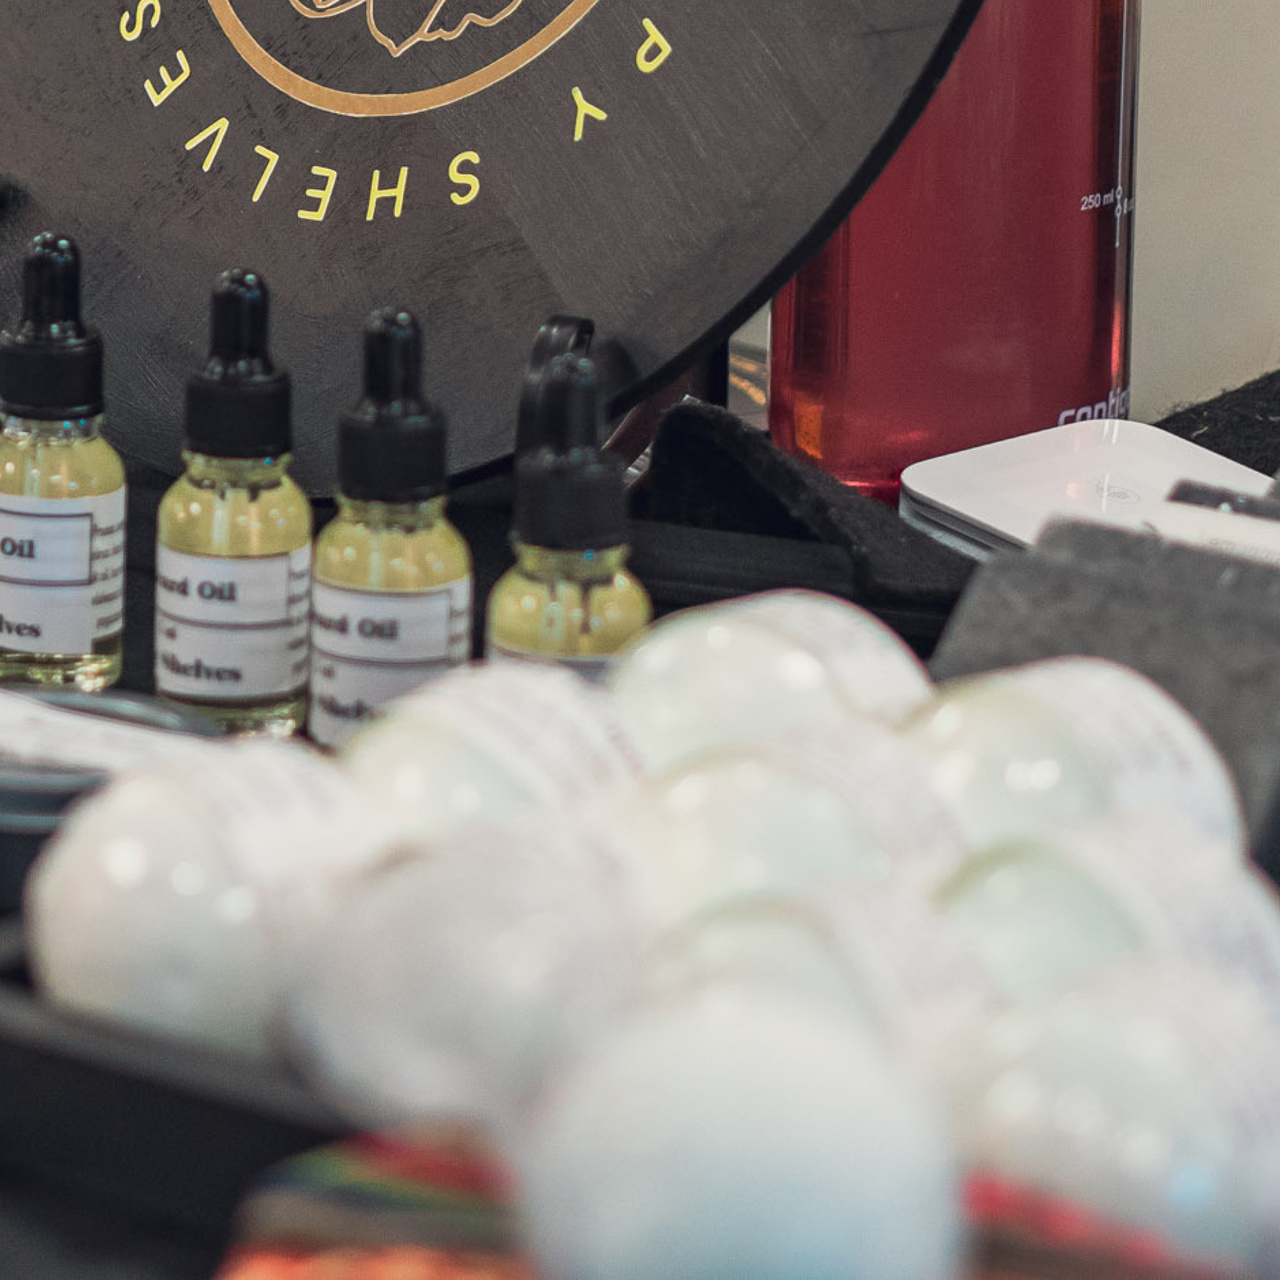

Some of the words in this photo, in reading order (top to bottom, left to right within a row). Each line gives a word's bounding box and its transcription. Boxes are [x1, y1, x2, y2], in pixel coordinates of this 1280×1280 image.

[1080, 193, 1101, 211] 250
[1102, 188, 1114, 206] ml
[0, 536, 36, 559] Oil
[196, 580, 237, 602] Oil
[356, 617, 400, 641] Oil
